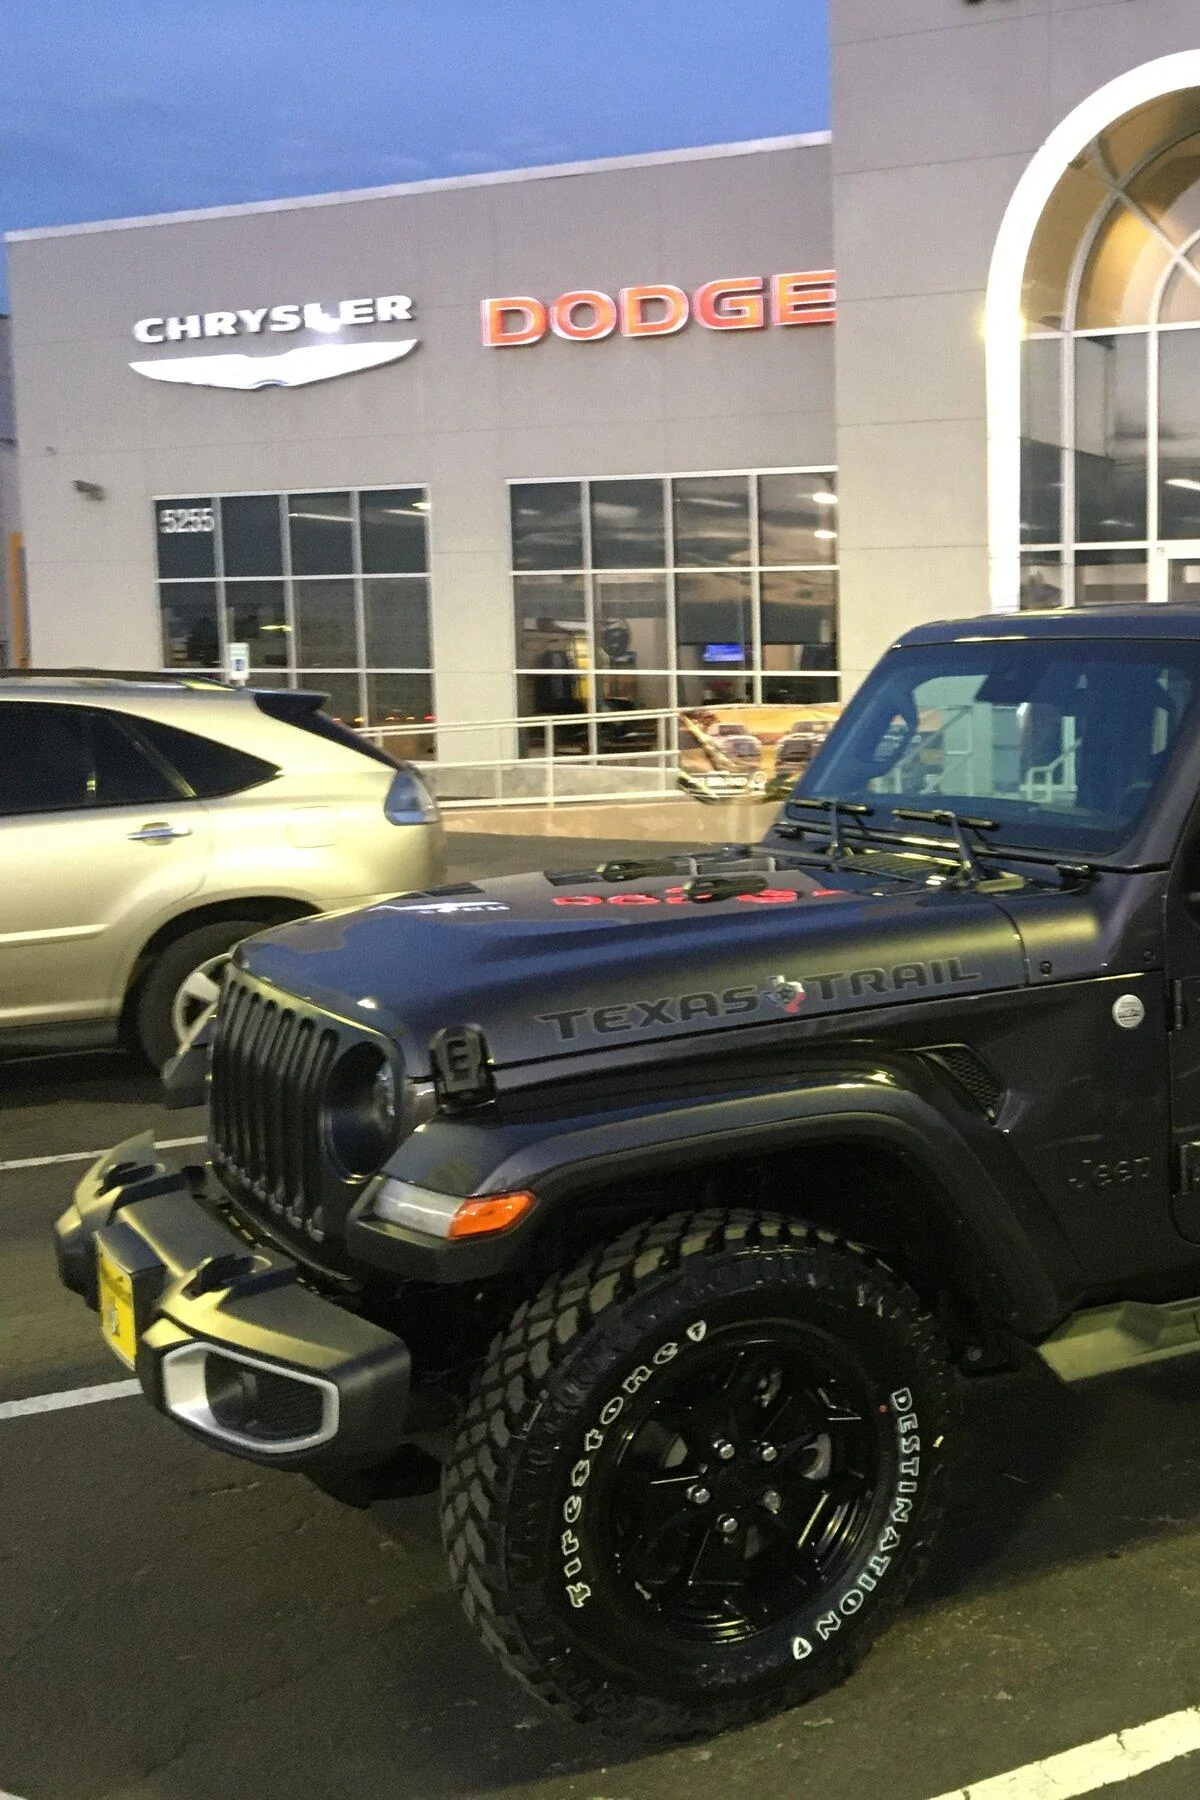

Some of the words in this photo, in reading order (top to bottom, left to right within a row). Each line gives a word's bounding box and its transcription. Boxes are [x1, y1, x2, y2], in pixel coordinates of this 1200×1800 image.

[134, 295, 413, 343] CHRYSLER
[480, 269, 837, 346] DODGE
[160, 508, 214, 533] 5255
[538, 984, 760, 1041] TEXAS
[803, 957, 981, 1001] TRAIL
[815, 1386, 921, 1641] DESTINATION
